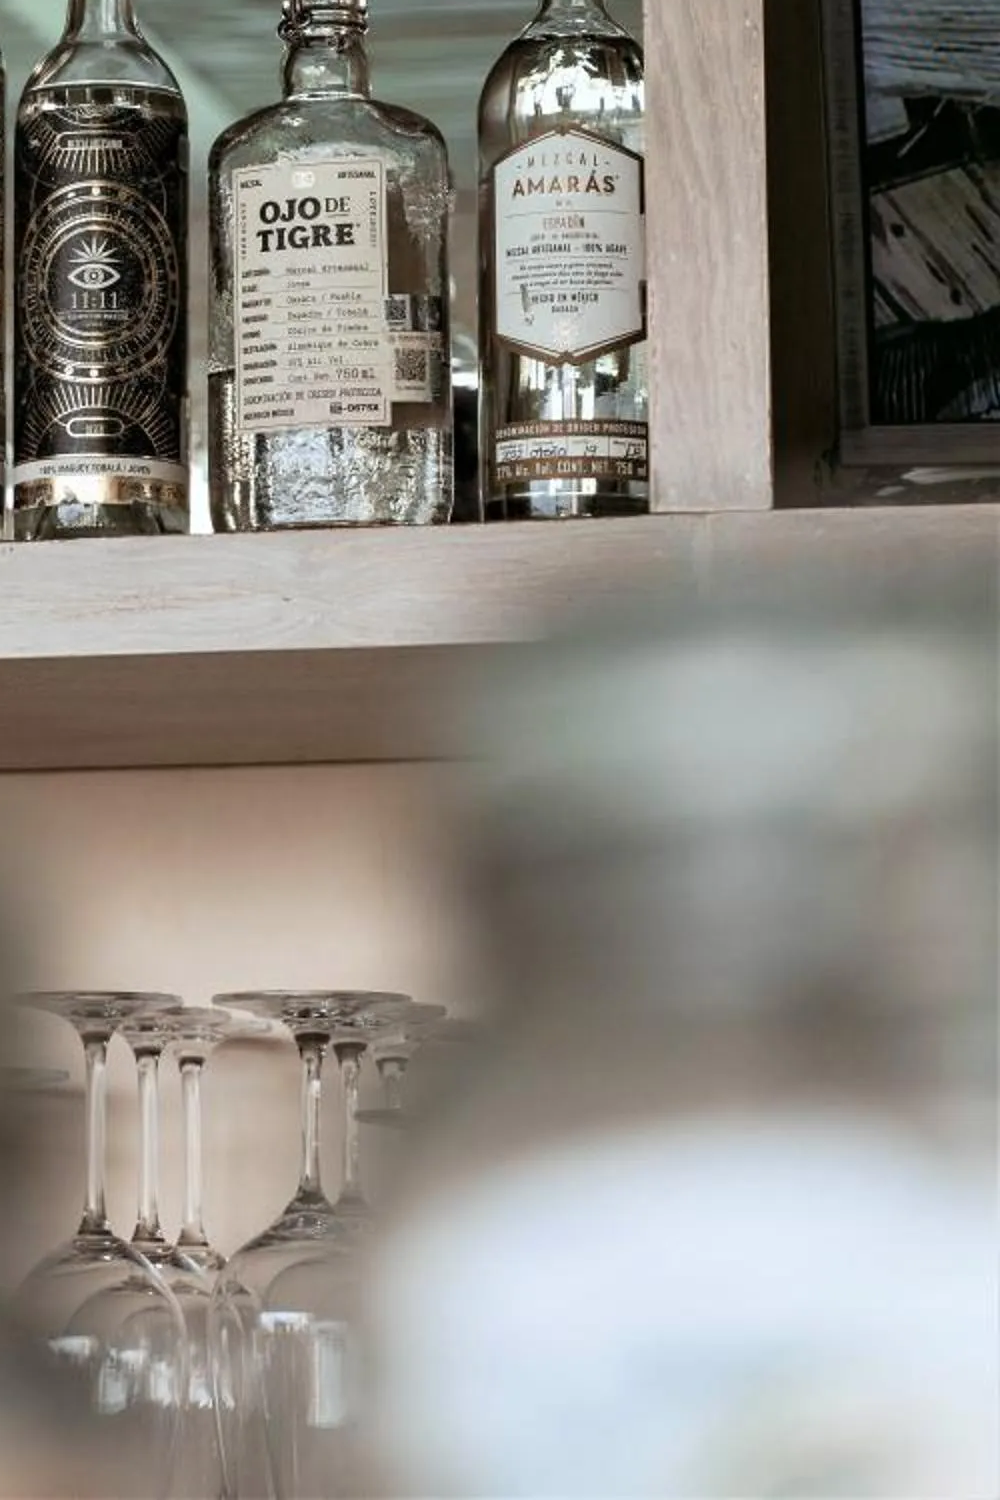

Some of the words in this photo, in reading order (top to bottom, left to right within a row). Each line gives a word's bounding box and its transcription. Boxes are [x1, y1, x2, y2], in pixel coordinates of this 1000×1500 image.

[526, 151, 600, 169] MEZCAL
[512, 169, 617, 199] AMARÁS
[258, 196, 322, 225] OJO
[324, 197, 351, 214] DE
[256, 222, 356, 253] TIGRE
[70, 290, 120, 311] 11:11
[335, 368, 359, 380] 750
